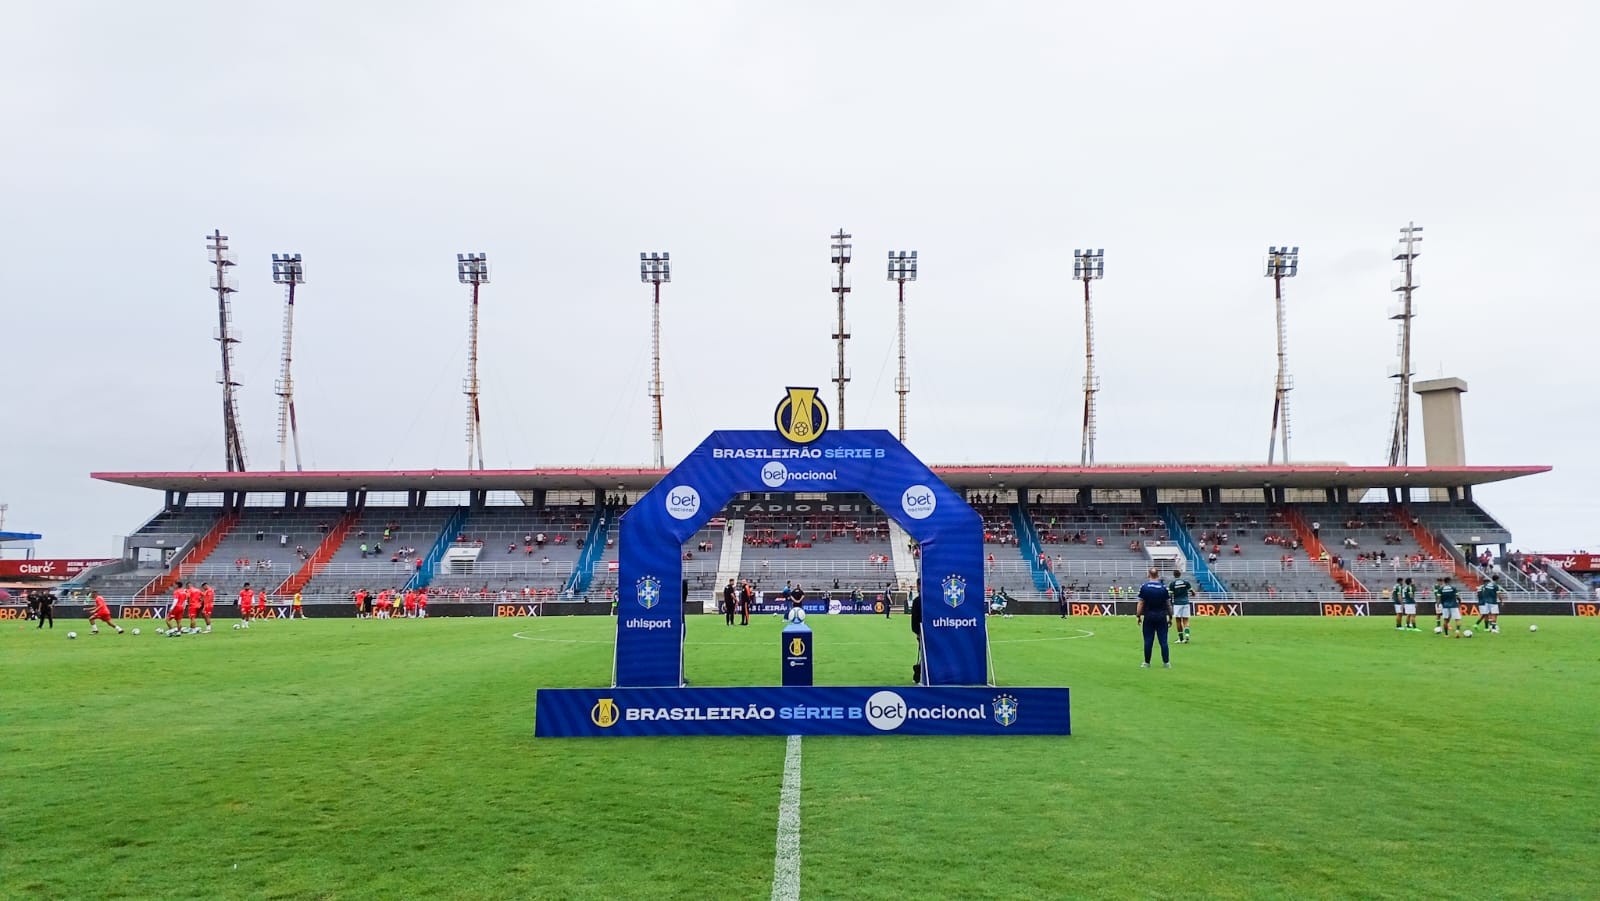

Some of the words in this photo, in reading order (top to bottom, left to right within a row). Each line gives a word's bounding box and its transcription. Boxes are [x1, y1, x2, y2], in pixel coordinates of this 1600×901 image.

[713, 446, 822, 459] BRASILEIRÃO
[824, 446, 872, 459] SÉRIE
[874, 448, 886, 459] B
[763, 468, 786, 480] bet
[787, 469, 838, 481] nacional
[671, 491, 696, 507] bet
[906, 491, 932, 507] bet
[821, 503, 860, 512] REI
[20, 563, 51, 573] Claro
[0, 608, 28, 620] BRA
[123, 607, 165, 619] BRAX
[497, 605, 538, 617] BRAX
[1071, 604, 1112, 616] BRAX
[1197, 603, 1238, 616] BRAX
[1324, 604, 1365, 616] BRAX
[626, 617, 671, 630] uhlsport
[932, 617, 977, 629] uhlsport
[625, 704, 775, 721] BRASILEIRÃO
[779, 704, 844, 720] SÉRIE
[848, 706, 862, 720] B
[869, 701, 904, 719] bet
[907, 703, 987, 720] nacional
